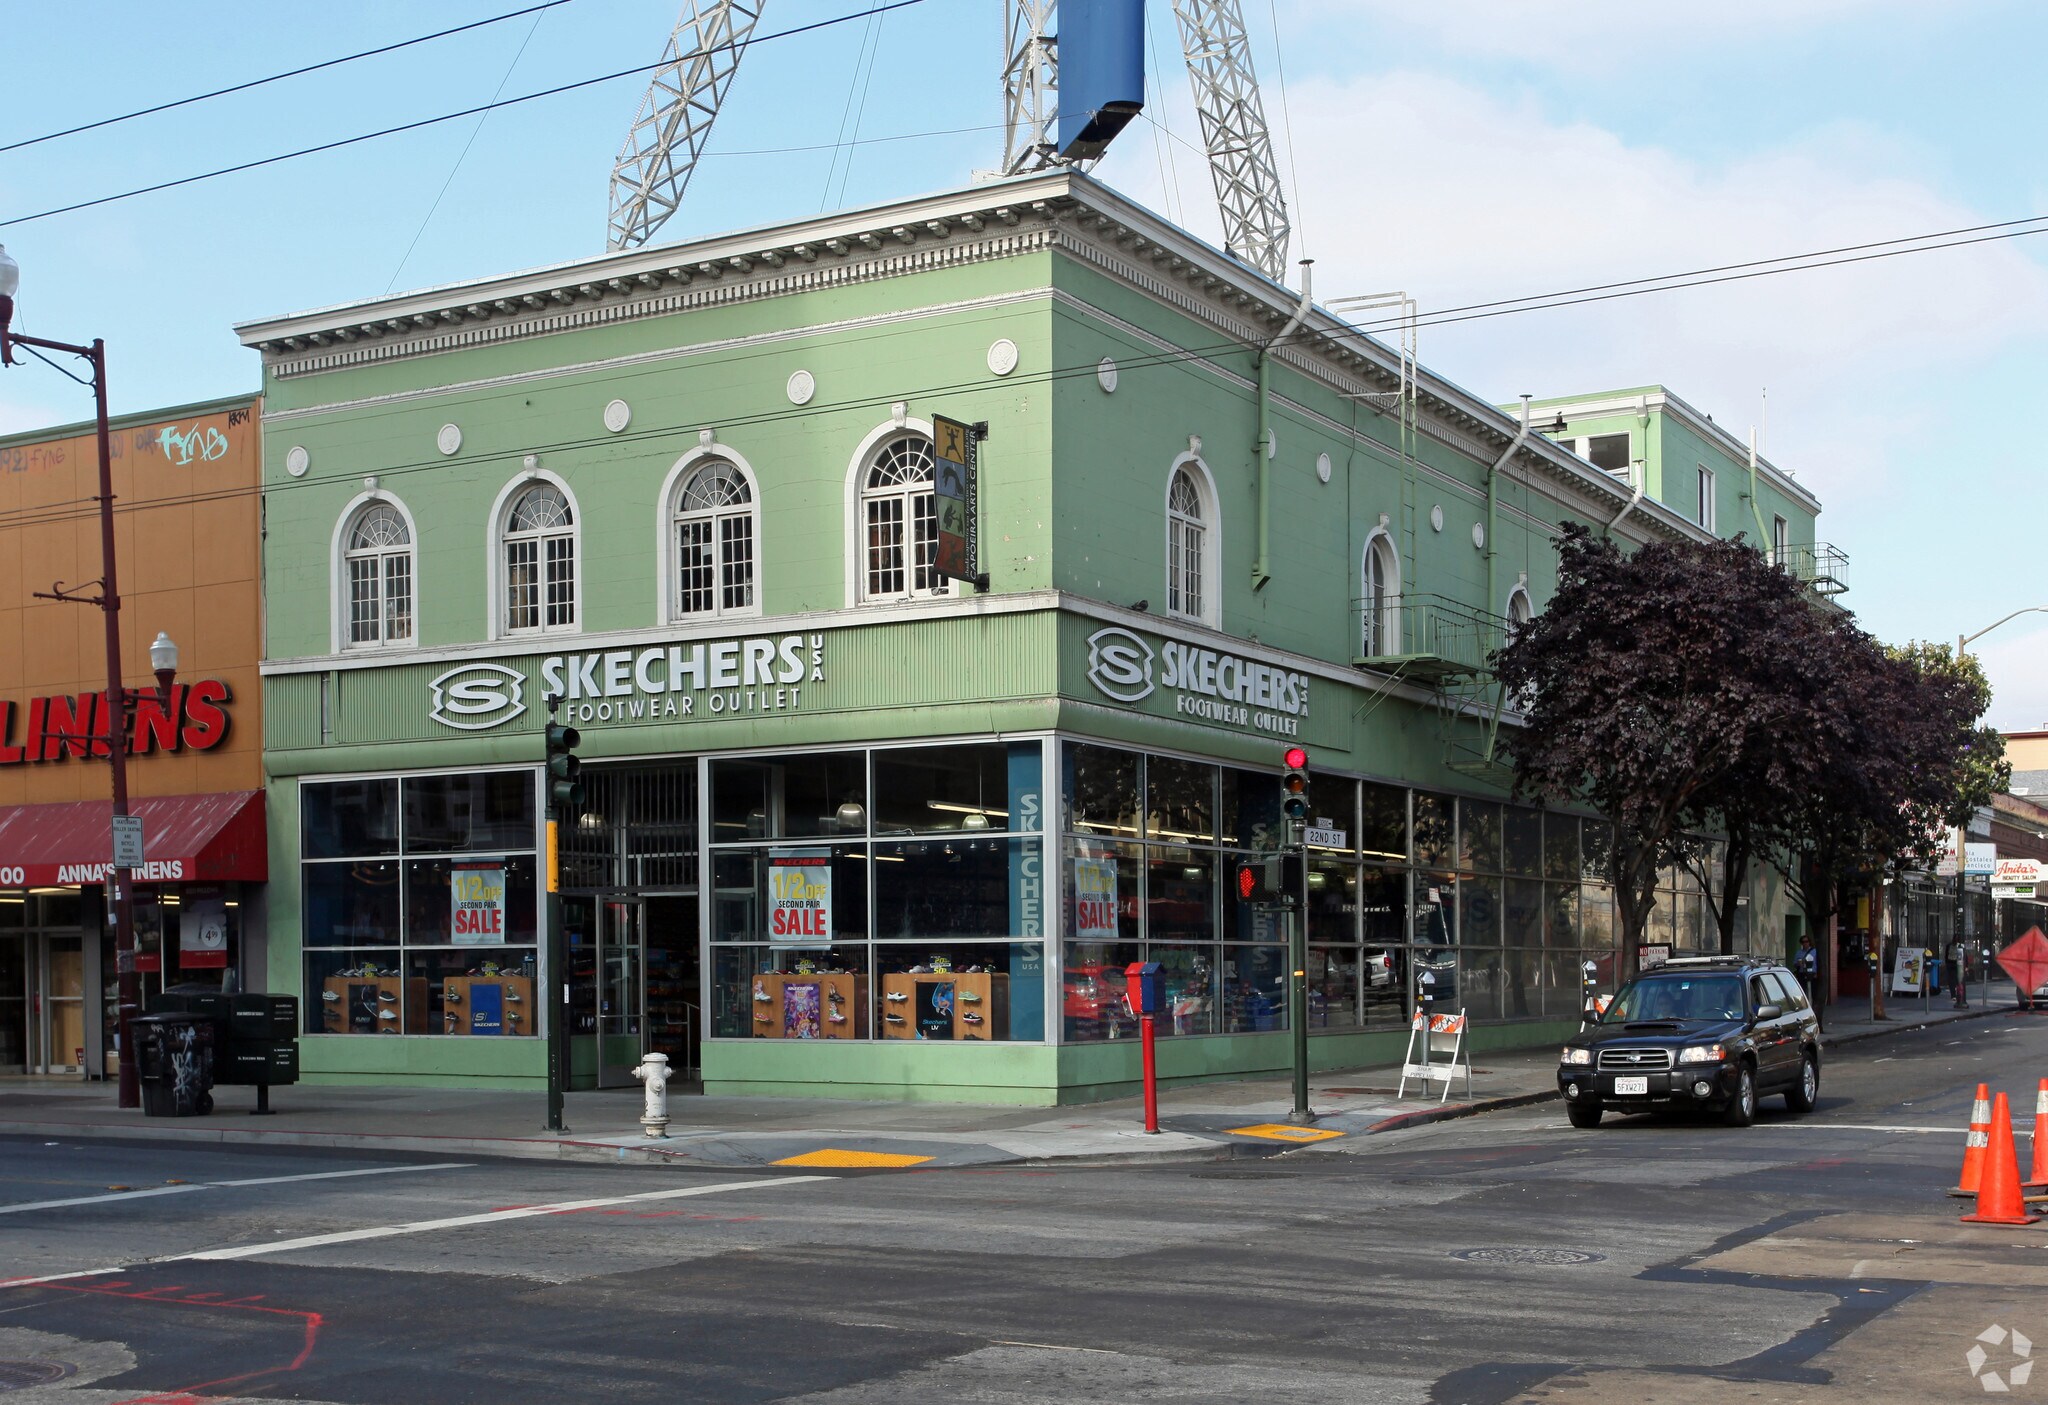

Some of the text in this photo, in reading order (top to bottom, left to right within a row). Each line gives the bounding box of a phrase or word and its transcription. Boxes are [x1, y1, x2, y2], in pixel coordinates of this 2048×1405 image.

[541, 635, 806, 702] SKECHERS
[811, 635, 825, 682] USA
[1161, 640, 1300, 715] SKECHERS
[566, 687, 801, 723] FOOTWEAR OUTLET
[1300, 675, 1309, 717] USA
[1176, 694, 1298, 736] FOOTWEAR OUTLET
[1310, 831, 1340, 845] 22ND ST
[57, 859, 183, 883] ANNA'S INENS
[773, 858, 827, 866] SKECHERS
[1994, 861, 2038, 877] Anita's
[774, 872, 827, 900] 1/2 OFF
[1020, 794, 1040, 962] SKECHERS
[460, 901, 497, 909] SECOND PAIR
[778, 900, 821, 908] SECOND PAIR
[1078, 901, 1115, 929] SALE
[455, 909, 502, 934] SALE
[773, 908, 827, 935] SALE
[1640, 947, 1648, 956] NO
